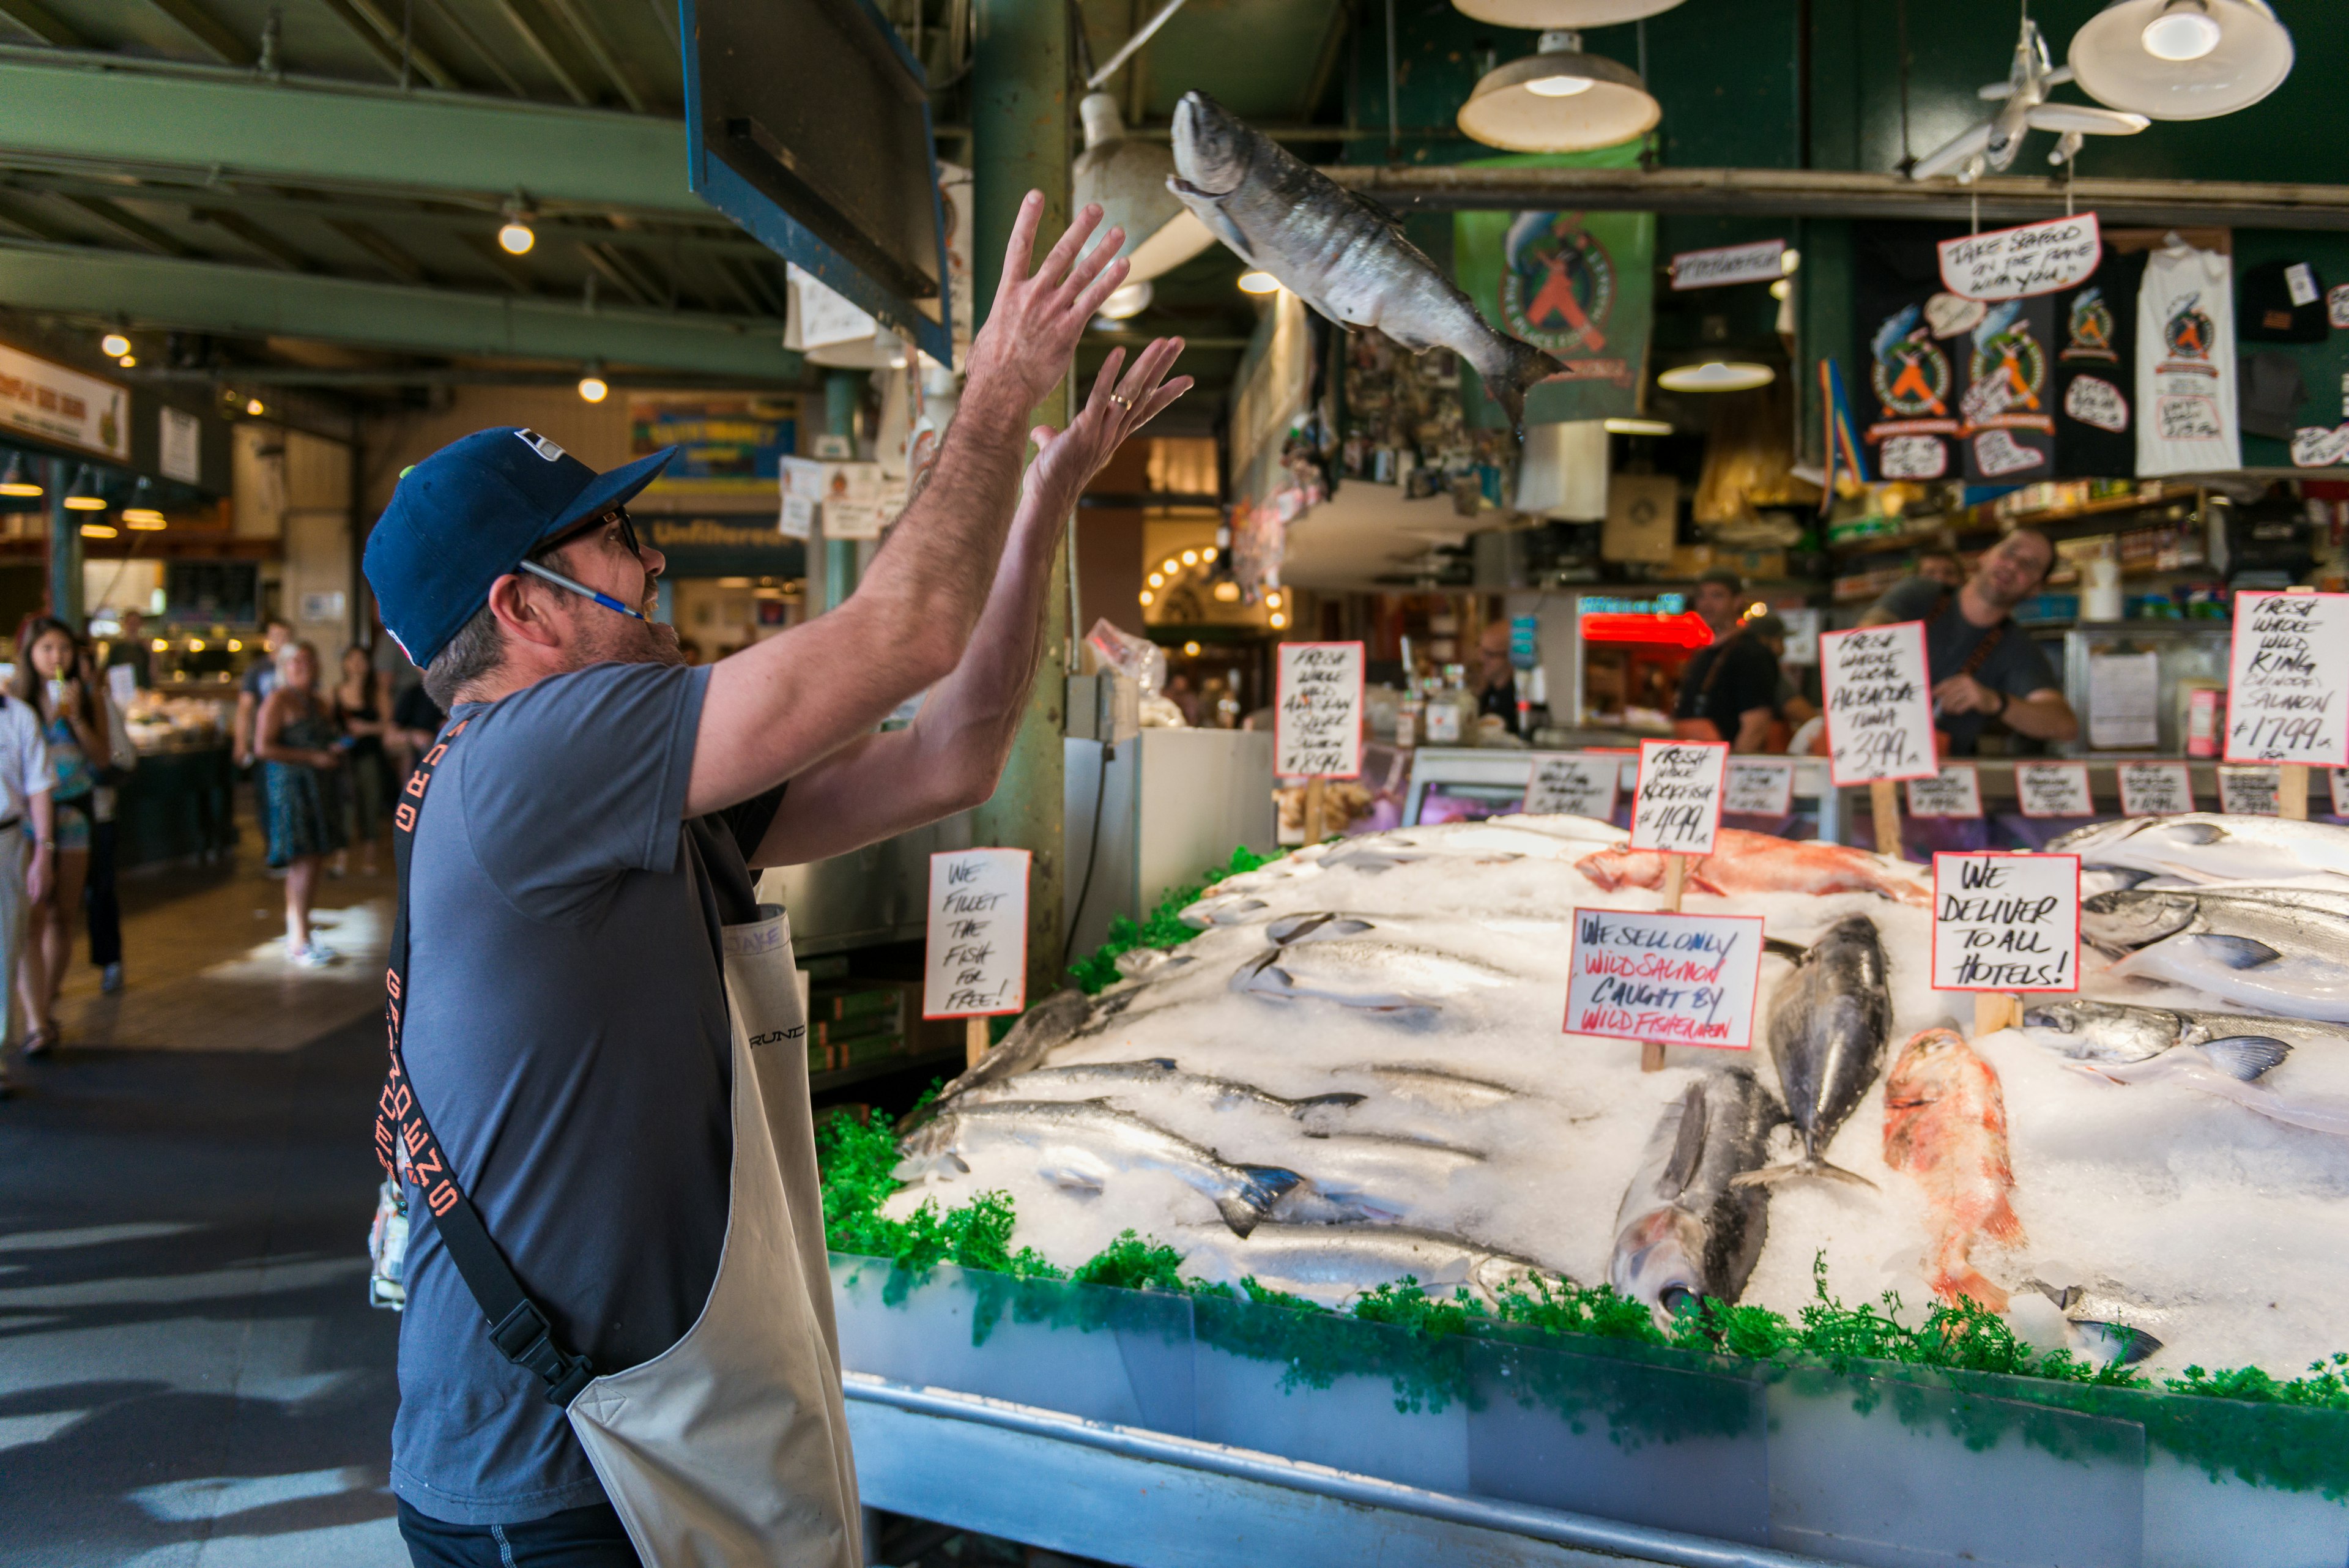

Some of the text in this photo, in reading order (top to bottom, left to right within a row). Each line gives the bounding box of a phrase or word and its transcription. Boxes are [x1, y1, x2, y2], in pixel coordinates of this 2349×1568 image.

[1946, 239, 2003, 264] TAKE
[1972, 260, 1995, 275] ON
[2005, 252, 2039, 270] THE
[2260, 634, 2309, 651] WILD
[2248, 650, 2317, 675] KING
[2240, 687, 2336, 713] SALMON
[1652, 743, 1712, 765] FRESH
[1639, 781, 1715, 801] ROCKFISH
[948, 859, 985, 885] WE
[1961, 855, 2016, 890] WE
[942, 888, 1008, 913] FILLET
[1937, 893, 2058, 926] DELIVER
[946, 920, 992, 939] THE
[1953, 927, 2052, 953] TO ALL
[943, 942, 995, 967] FISH
[1581, 914, 1738, 972] WE SELL ONLY
[956, 968, 985, 986] FOR
[1586, 949, 1726, 984] WILD SALMON
[1952, 949, 2069, 986] HOTELS!
[944, 979, 1008, 1010] FREE!
[1590, 976, 1724, 1030] CAUGHT BY
[1581, 1003, 1732, 1039] WILD FISHERMEN
